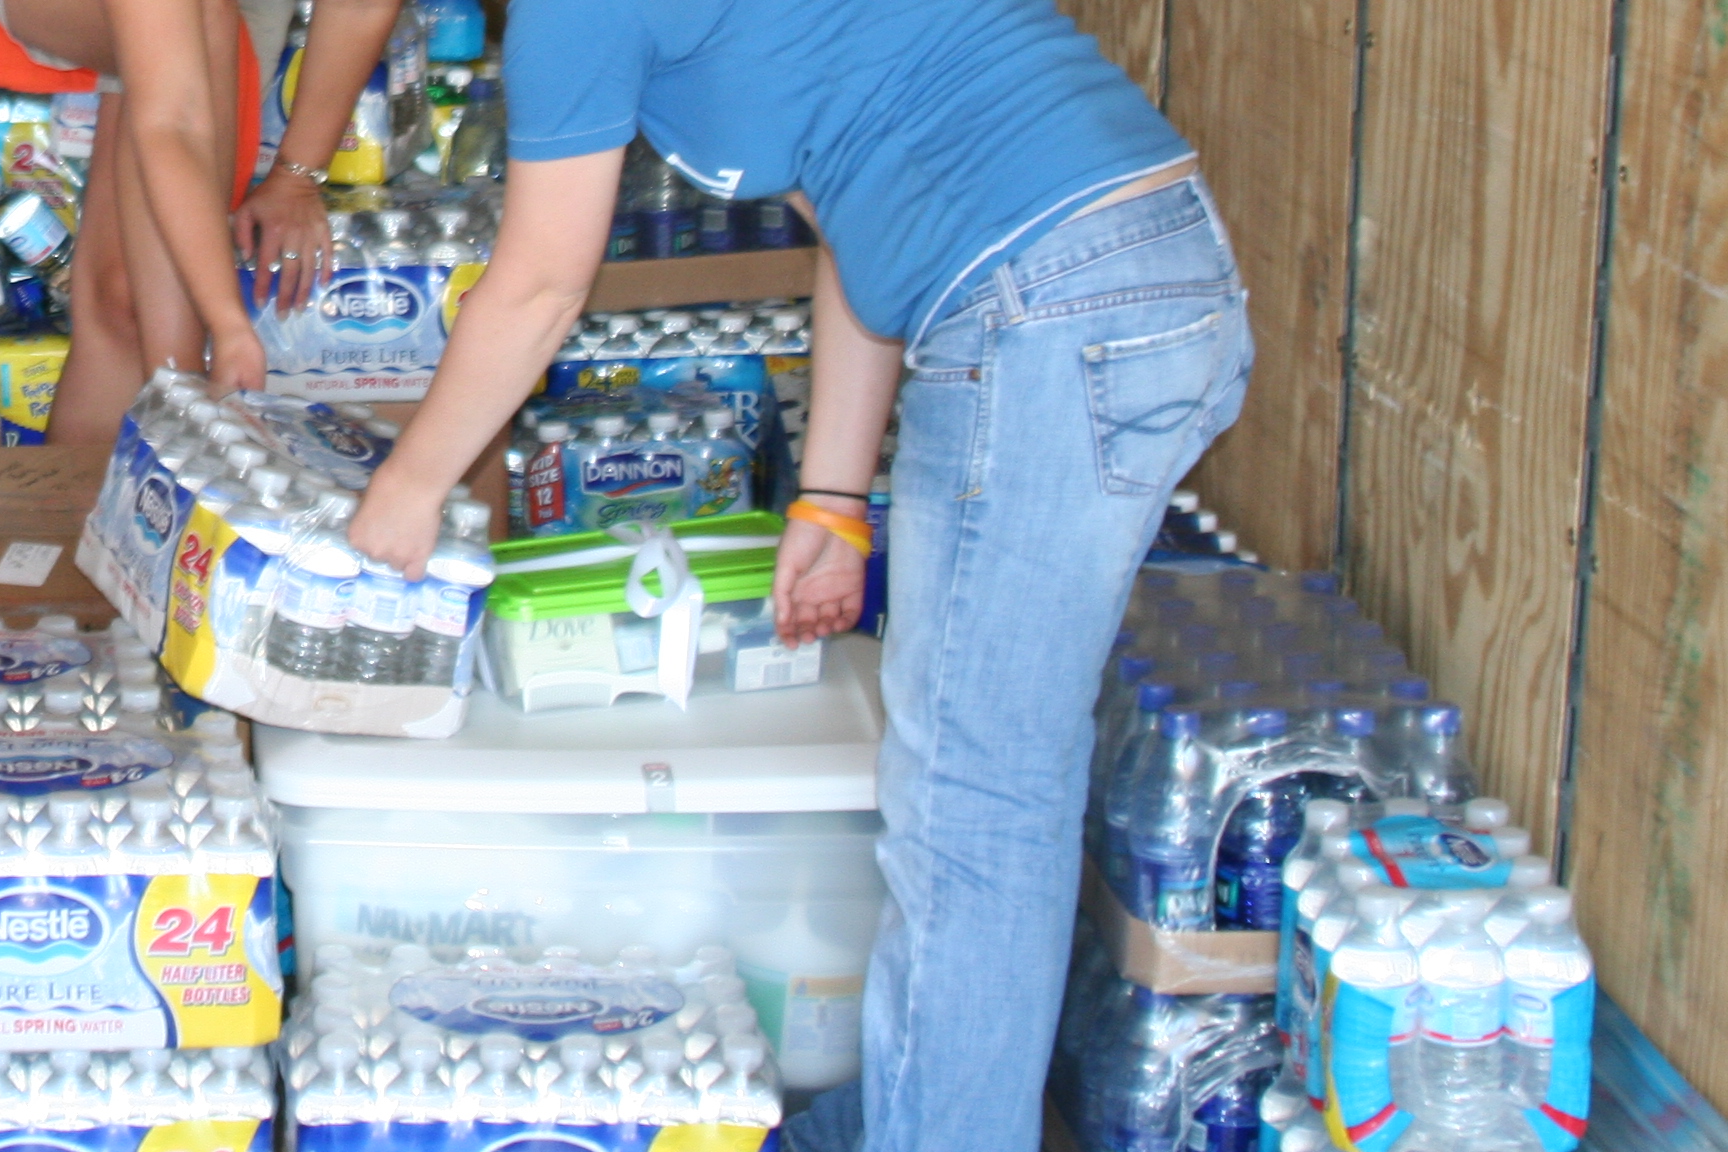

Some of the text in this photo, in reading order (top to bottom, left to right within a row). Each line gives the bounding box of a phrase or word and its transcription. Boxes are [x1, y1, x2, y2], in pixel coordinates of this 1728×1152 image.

[322, 349, 420, 364] PURE LIFE
[353, 377, 400, 390] SPRING
[530, 455, 554, 473] KID
[587, 459, 682, 483] DANNON
[529, 467, 561, 488] SIZE
[536, 487, 553, 506] 12
[176, 532, 214, 588] 24
[528, 616, 595, 641] Dove
[650, 772, 668, 787] 2
[146, 904, 237, 958] 24
[161, 964, 248, 985] HALF LITER
[48, 982, 104, 1002] LIFE
[182, 986, 252, 1006] BOTTLES
[13, 1018, 77, 1035] SPRING
[79, 1020, 124, 1035] WATER
